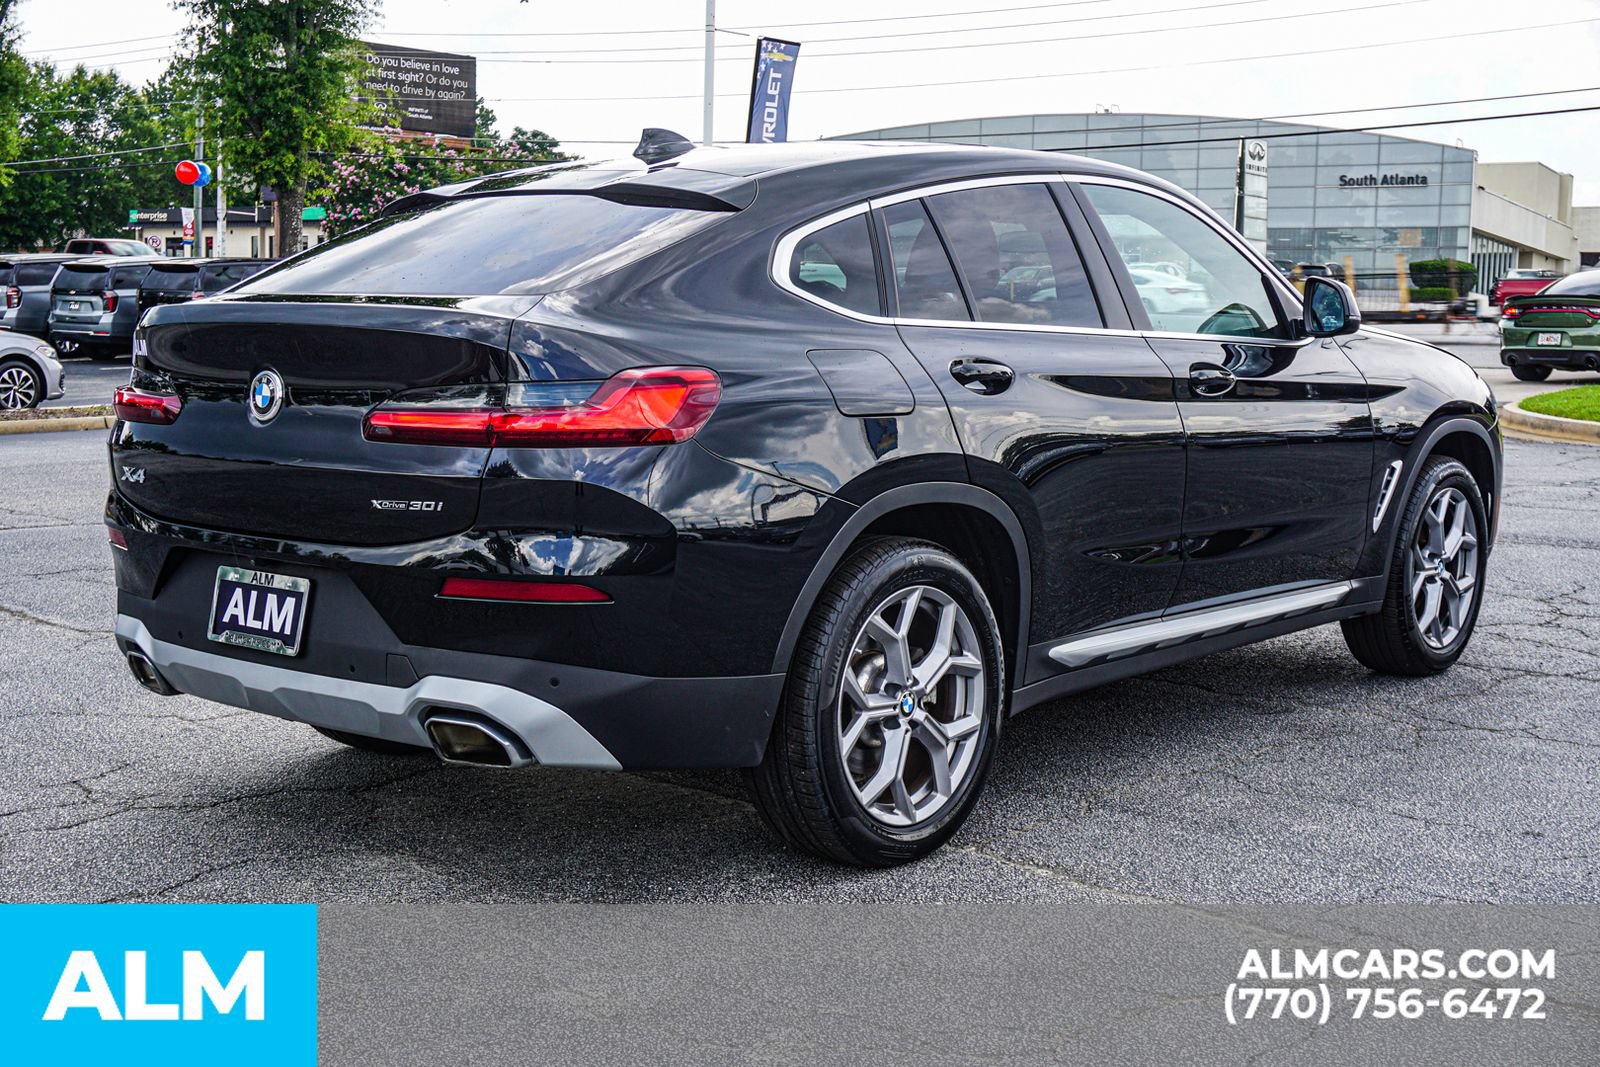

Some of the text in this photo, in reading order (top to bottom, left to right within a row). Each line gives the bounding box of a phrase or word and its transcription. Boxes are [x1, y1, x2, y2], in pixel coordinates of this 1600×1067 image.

[366, 53, 460, 75] Do you believe in love
[377, 67, 396, 80] first
[397, 72, 424, 84] sight?
[426, 73, 437, 84] Or
[439, 75, 450, 86] do
[452, 79, 468, 89] you
[365, 81, 465, 100] need to drive by again?
[1339, 173, 1428, 187] South Atlanta
[129, 210, 168, 221] enterprise
[121, 465, 145, 484] X4
[250, 571, 275, 587] ALM
[222, 587, 296, 636] ALM
